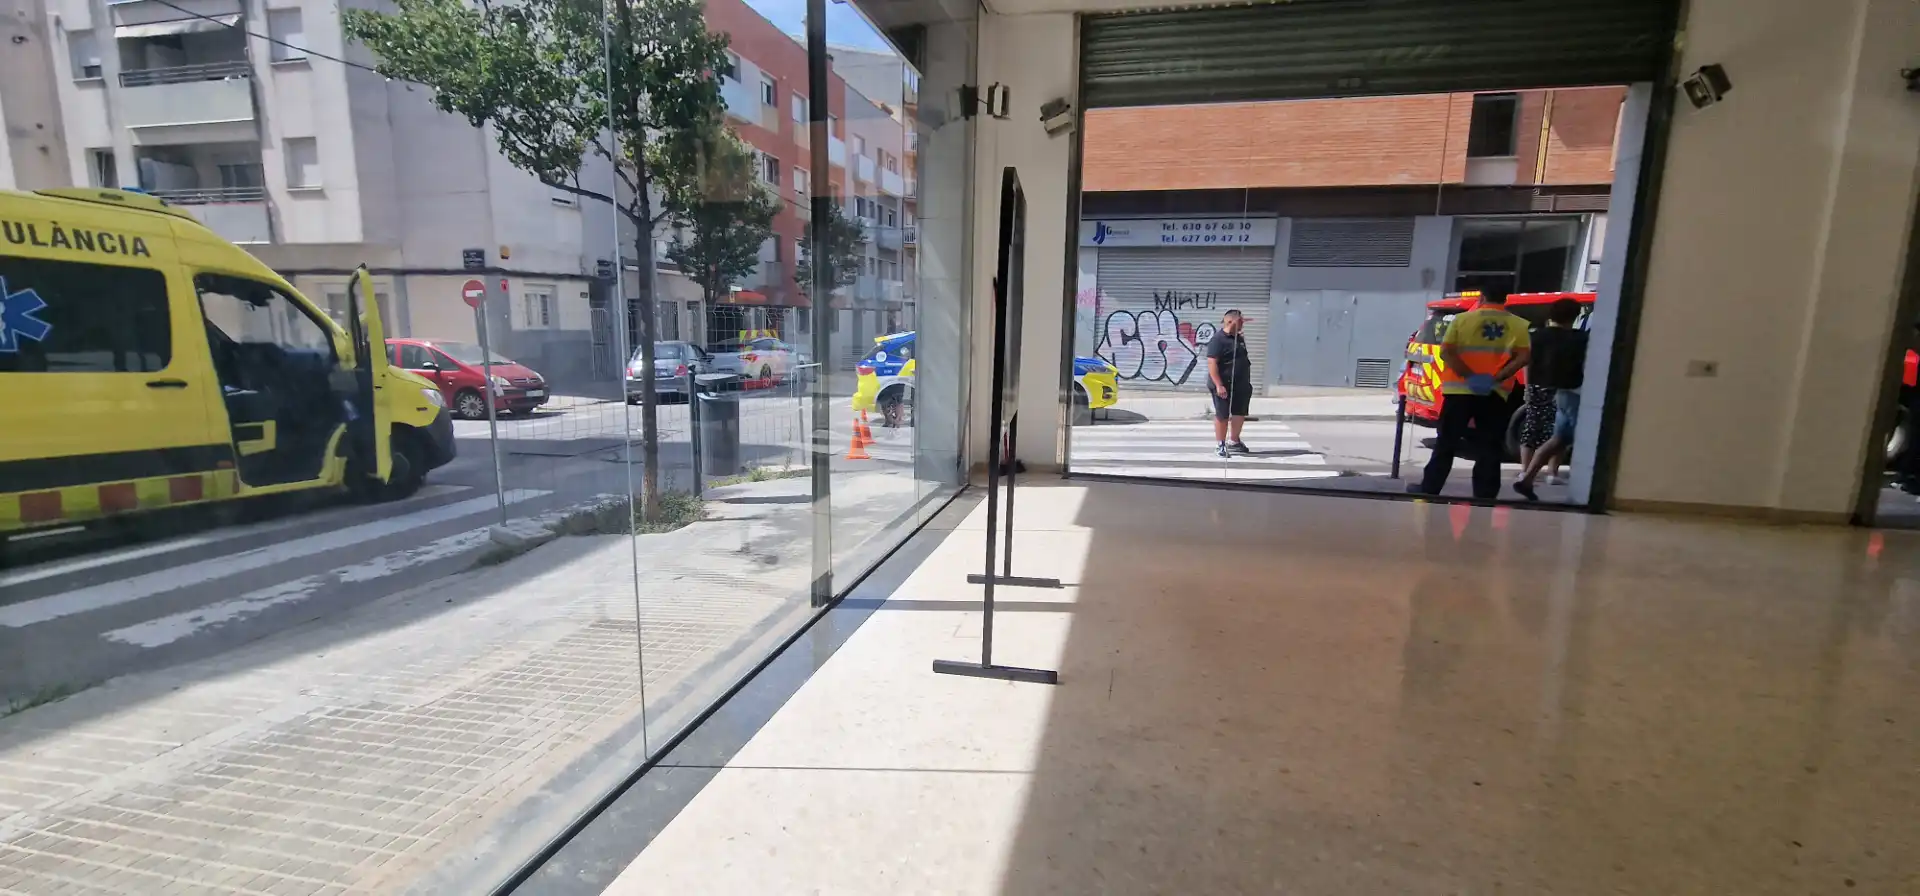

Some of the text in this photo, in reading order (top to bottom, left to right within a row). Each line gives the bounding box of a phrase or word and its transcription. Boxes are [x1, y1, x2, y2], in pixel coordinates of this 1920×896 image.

[1162, 222, 1178, 231] Tel.
[1204, 222, 1218, 231] 67
[1, 219, 152, 258] ULÀNCIA
[1161, 234, 1250, 243] Tel. 627 09 47 12
